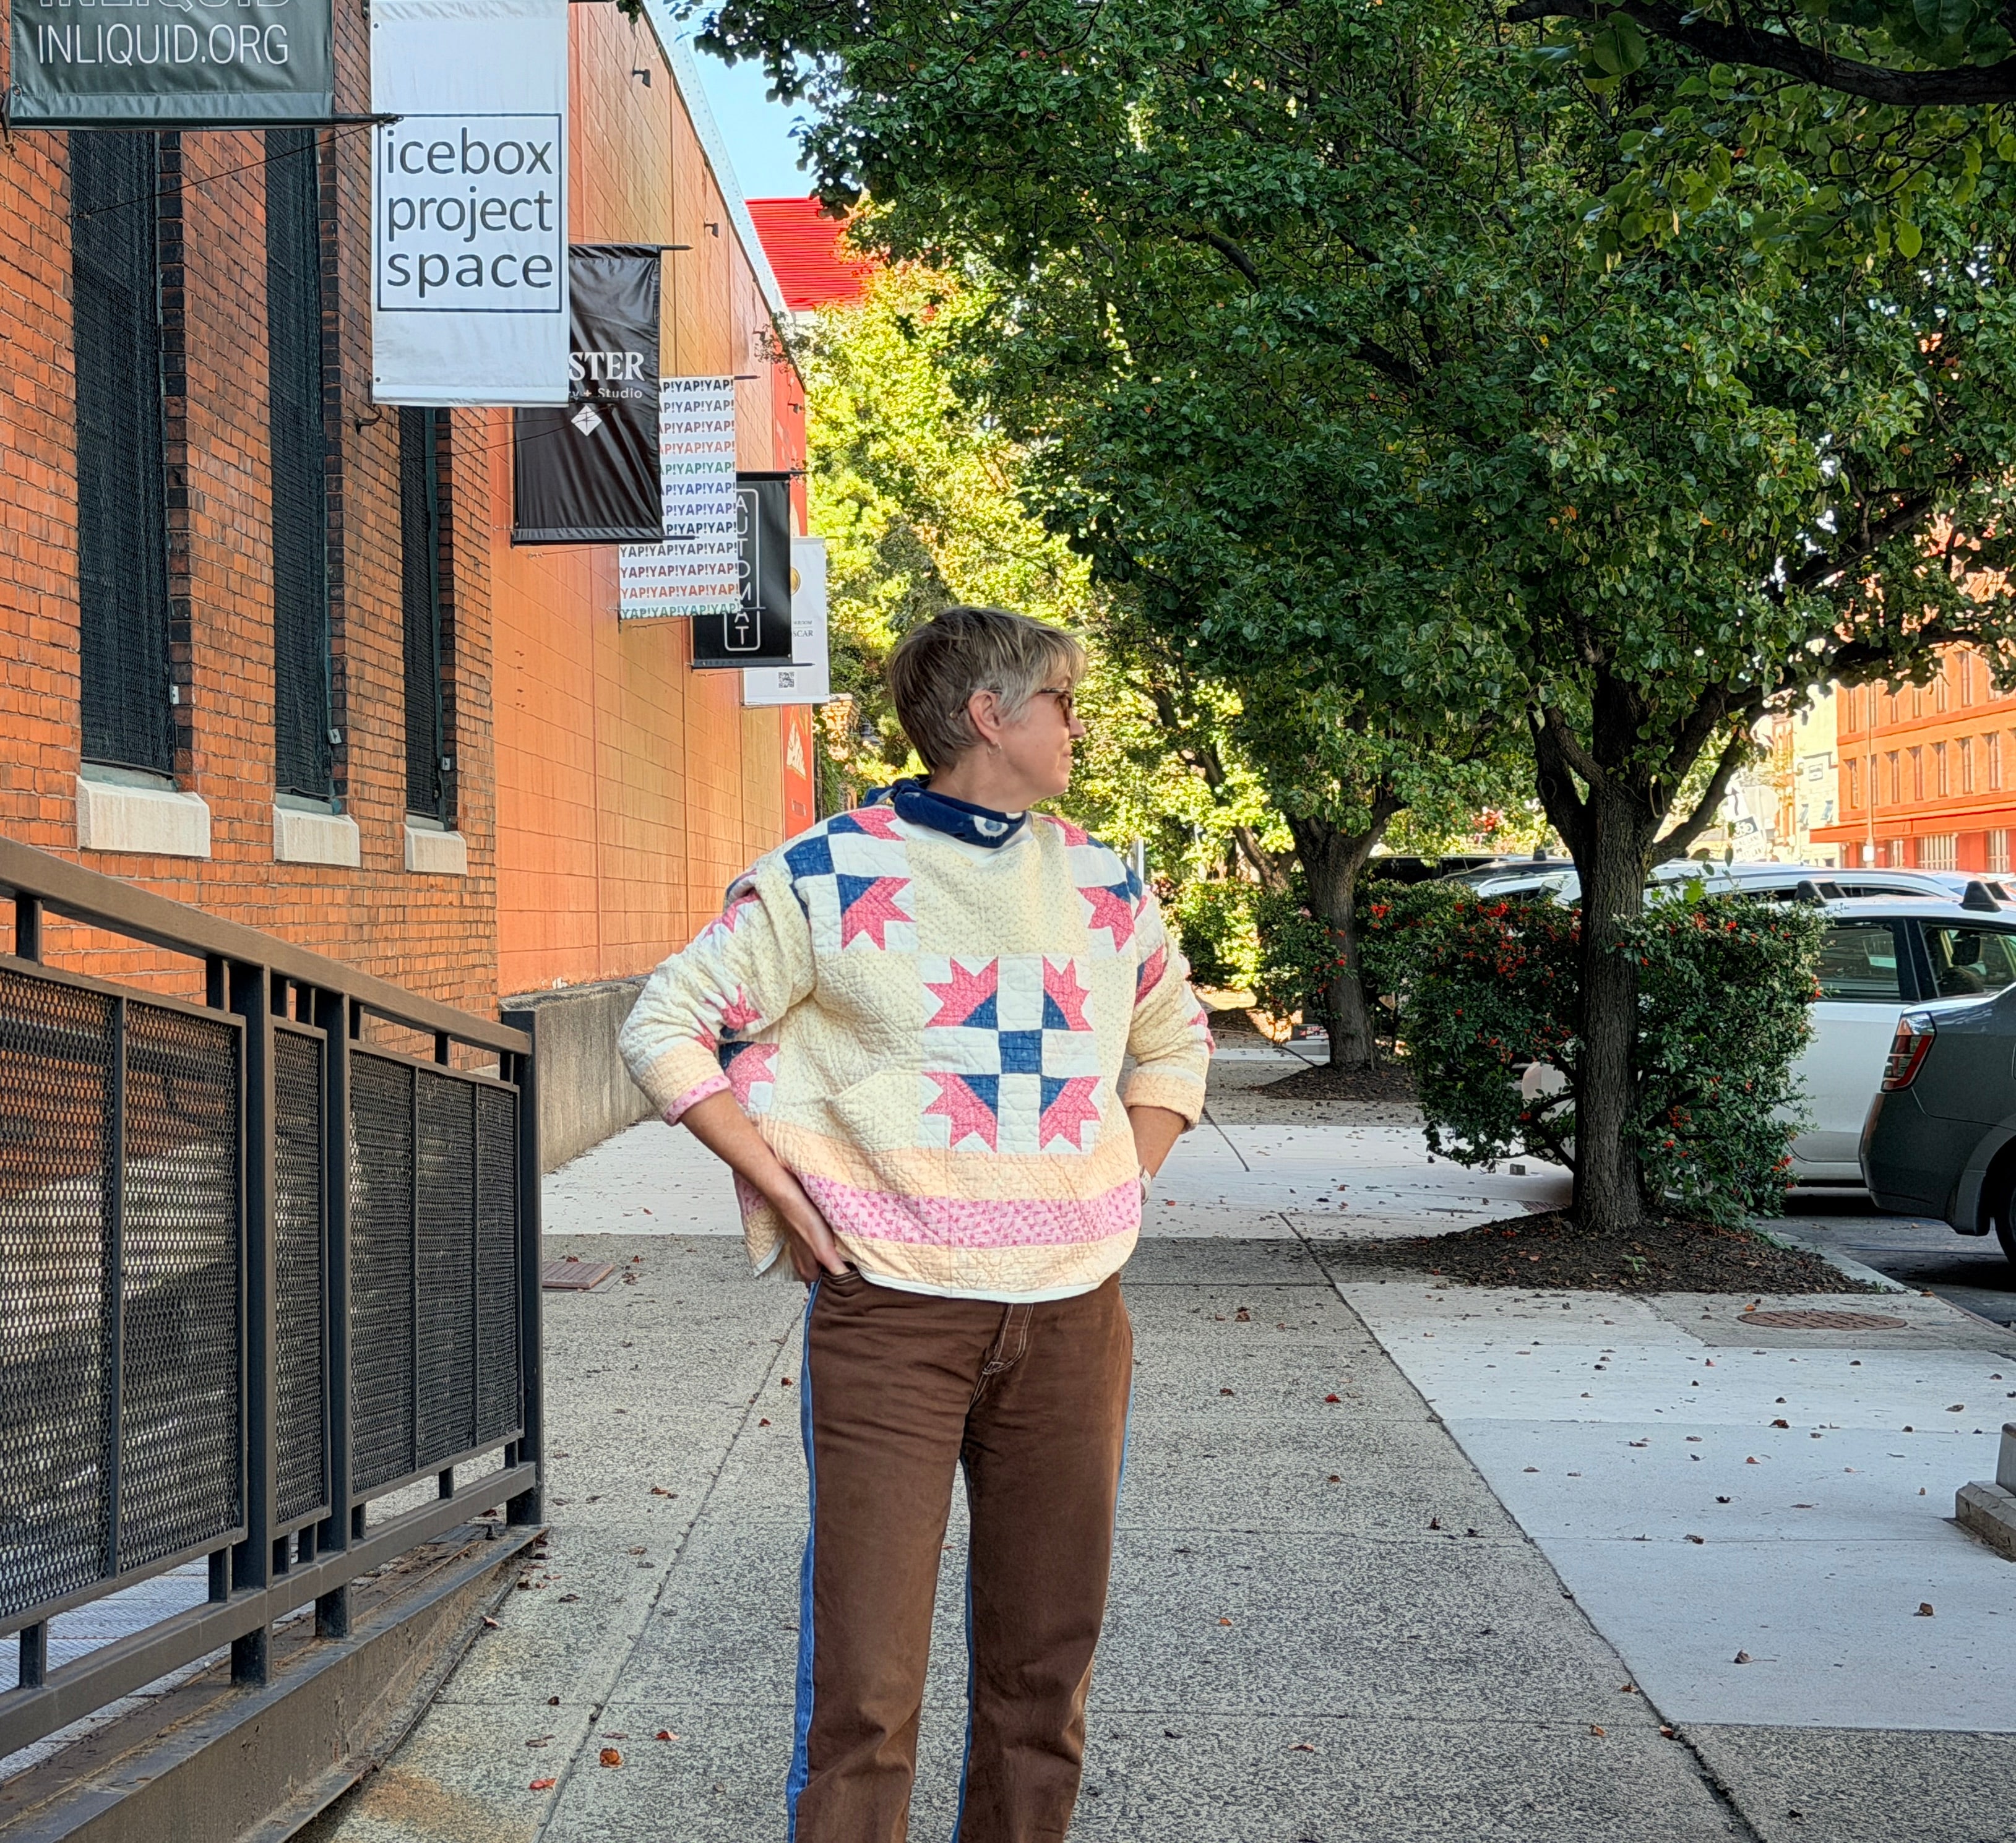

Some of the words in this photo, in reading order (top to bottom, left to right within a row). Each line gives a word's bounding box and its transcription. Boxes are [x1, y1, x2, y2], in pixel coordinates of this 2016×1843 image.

[38, 23, 289, 66] INLIQUID.ORG
[387, 126, 553, 174] icebox
[388, 186, 553, 243] project
[387, 253, 553, 298] space
[569, 351, 645, 382] STER
[598, 387, 642, 399] Studio
